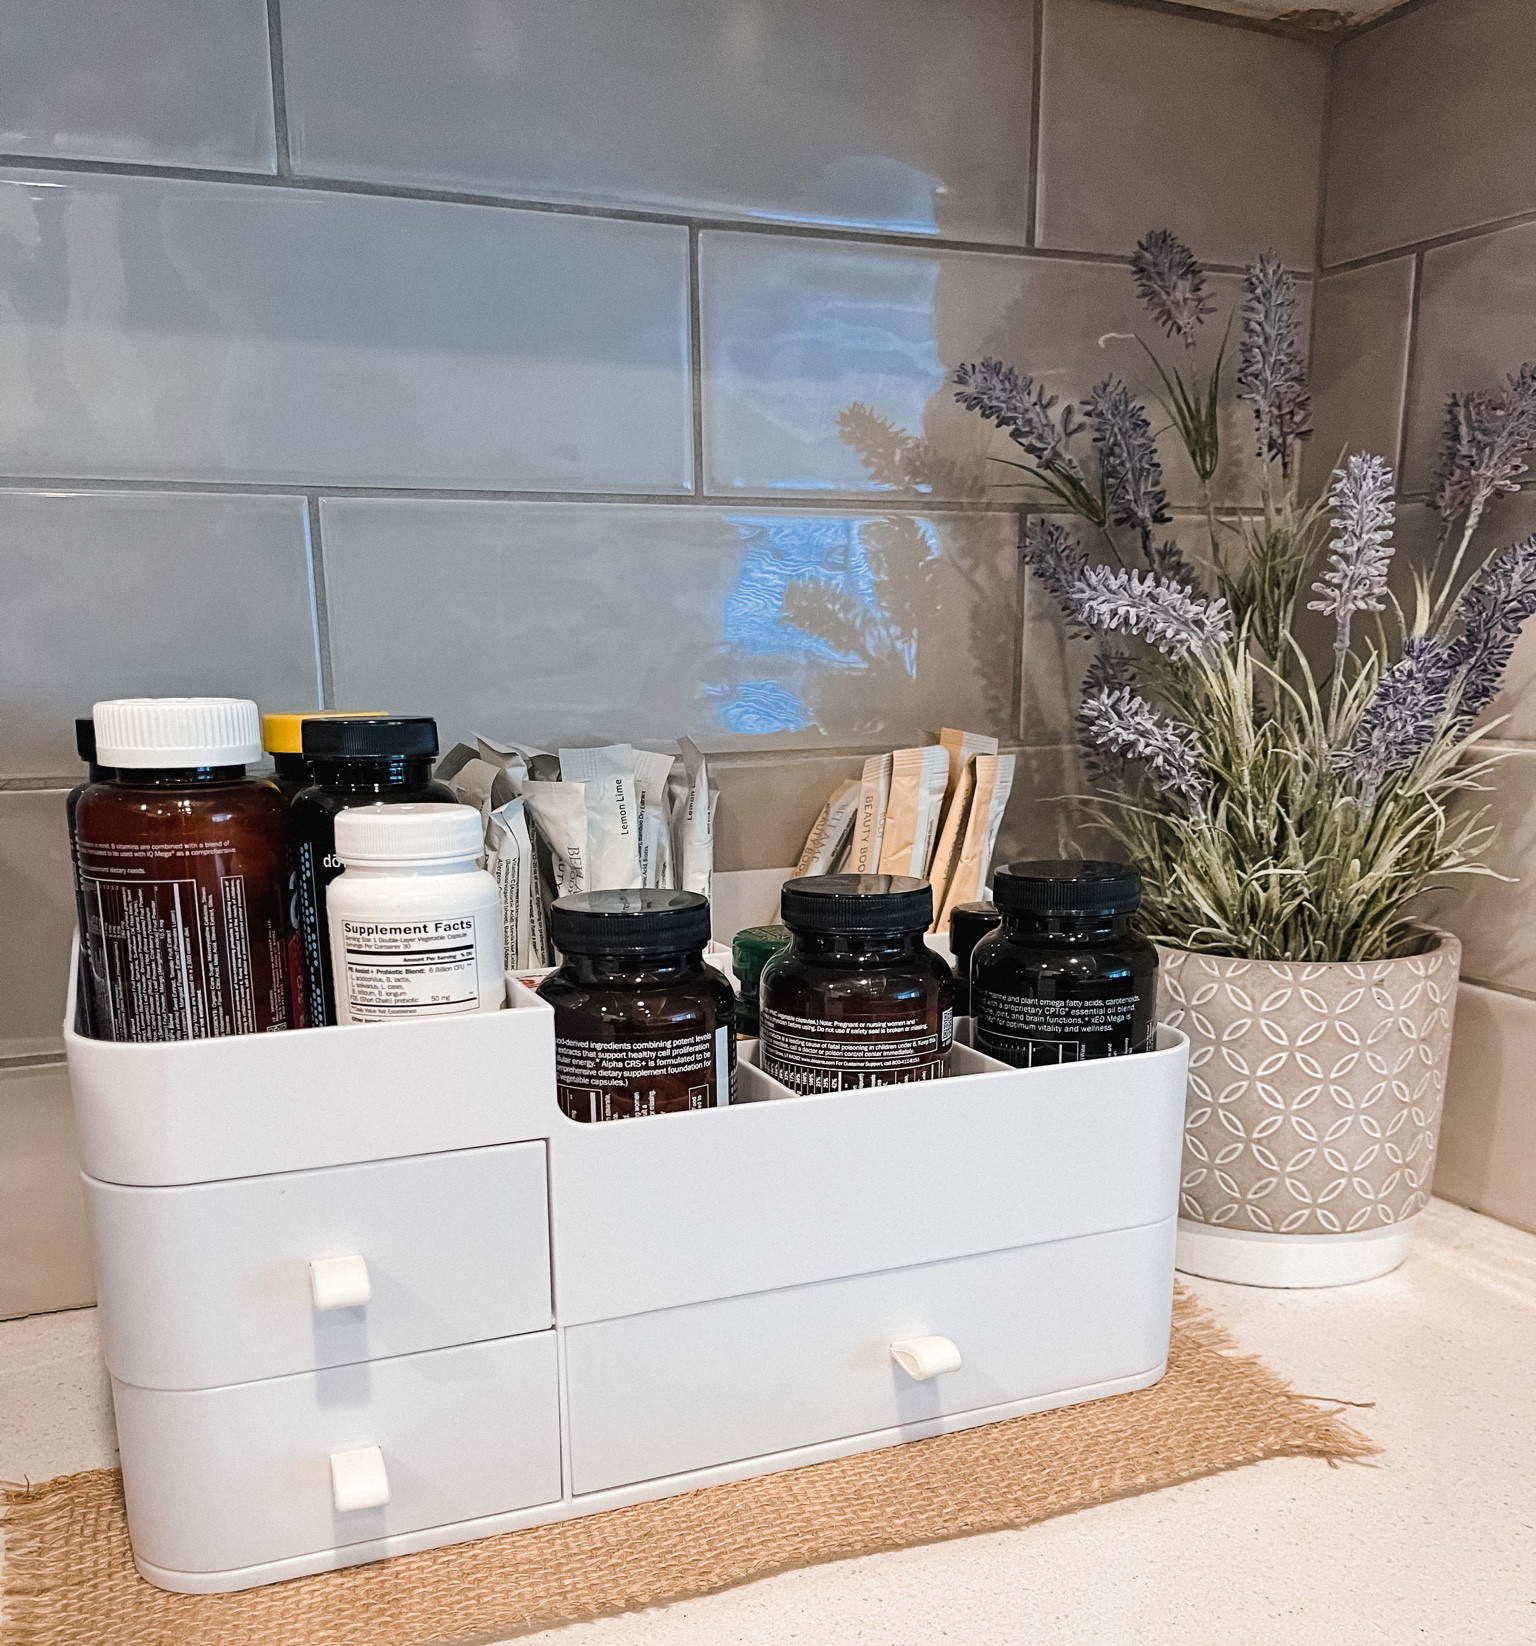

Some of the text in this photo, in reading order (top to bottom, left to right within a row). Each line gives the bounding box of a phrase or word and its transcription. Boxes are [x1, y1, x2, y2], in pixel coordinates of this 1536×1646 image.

[615, 779, 629, 836] Lemon Lime
[686, 790, 695, 821] Lemon
[857, 795, 874, 873] BEAUTY BOO
[191, 848, 236, 856] comprehensive
[344, 920, 472, 936] Supplement Facts
[1004, 1003, 1043, 1015] proprietary
[1070, 1007, 1106, 1015] essential
[1020, 997, 1038, 1005] plant
[1039, 999, 1065, 1008] omega
[1066, 999, 1082, 1008] fatty
[834, 1021, 858, 1029] Pregnant
[1011, 1013, 1024, 1021] and
[1025, 1014, 1045, 1022] brain
[1090, 1015, 1105, 1024] xEO
[1106, 1014, 1125, 1023] Mega
[851, 1027, 868, 1035] safety
[1005, 1020, 1037, 1030] optimum
[1037, 1024, 1063, 1034] vitality
[1064, 1025, 1079, 1033] and
[1080, 1024, 1113, 1033] wellness.
[590, 1041, 631, 1051] ingredients
[632, 1040, 672, 1049] combining
[673, 1036, 695, 1047] potent
[696, 1033, 712, 1042] levels
[828, 1042, 841, 1050] fatal
[841, 1043, 868, 1051] poisoning
[898, 1041, 912, 1049] under
[558, 1043, 710, 1060] extracts that support healthy cell proliferation
[601, 1060, 623, 1069] Alpha
[624, 1060, 648, 1068] CRS+
[648, 1059, 655, 1067] is
[657, 1054, 695, 1066] formulated
[598, 1069, 623, 1078] dietary
[623, 1069, 667, 1078] supplement
[667, 1062, 703, 1074] foundation
[703, 1060, 712, 1068] for
[560, 1075, 629, 1087] vegetable capsules.)
